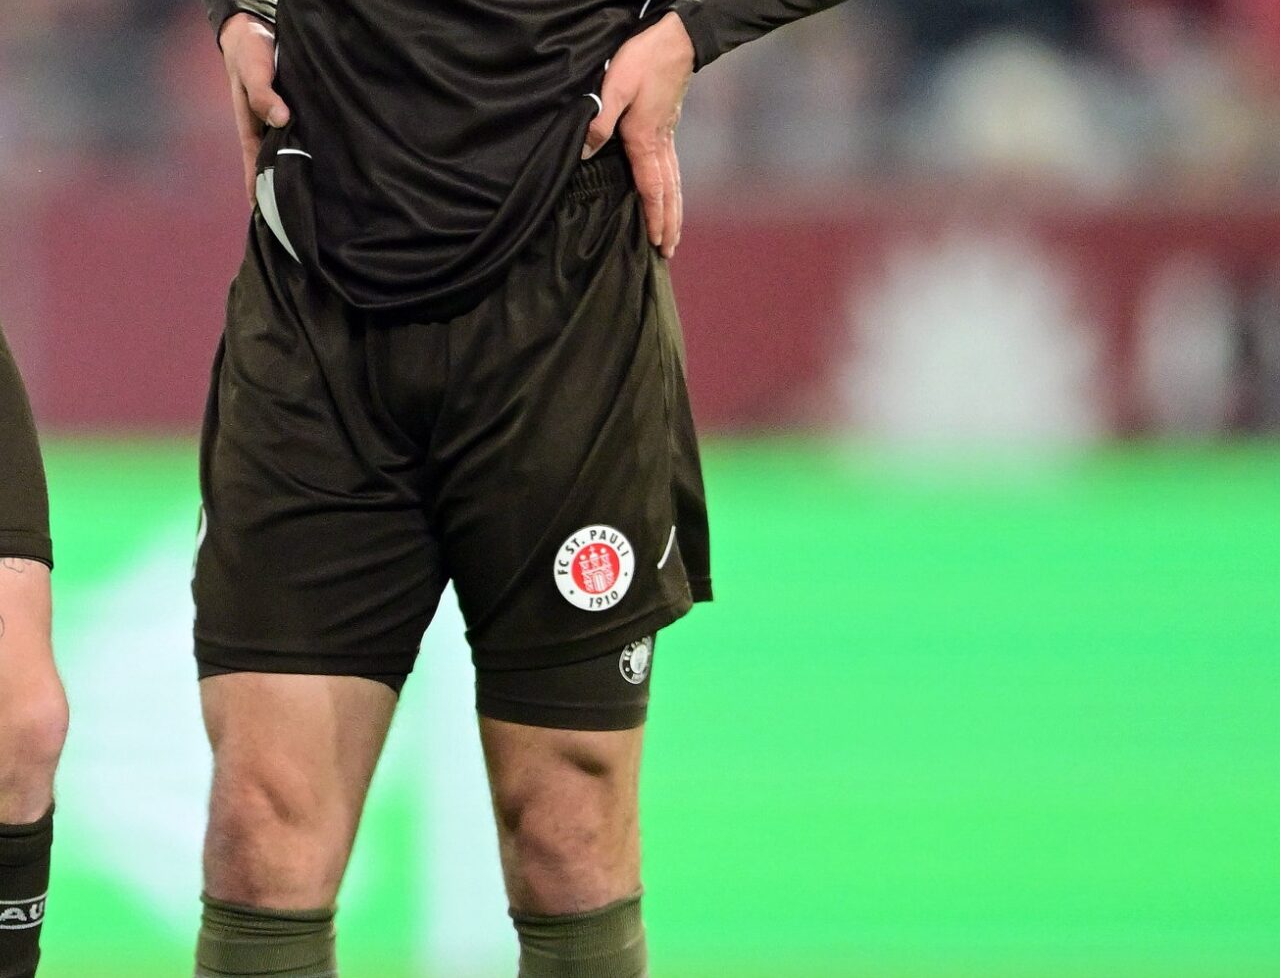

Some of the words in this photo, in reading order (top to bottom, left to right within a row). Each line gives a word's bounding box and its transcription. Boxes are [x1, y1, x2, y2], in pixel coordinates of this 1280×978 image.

[557, 559, 569, 575] FC
[565, 537, 585, 554] ST.
[589, 529, 629, 557] PAULI
[588, 590, 618, 609] 1910
